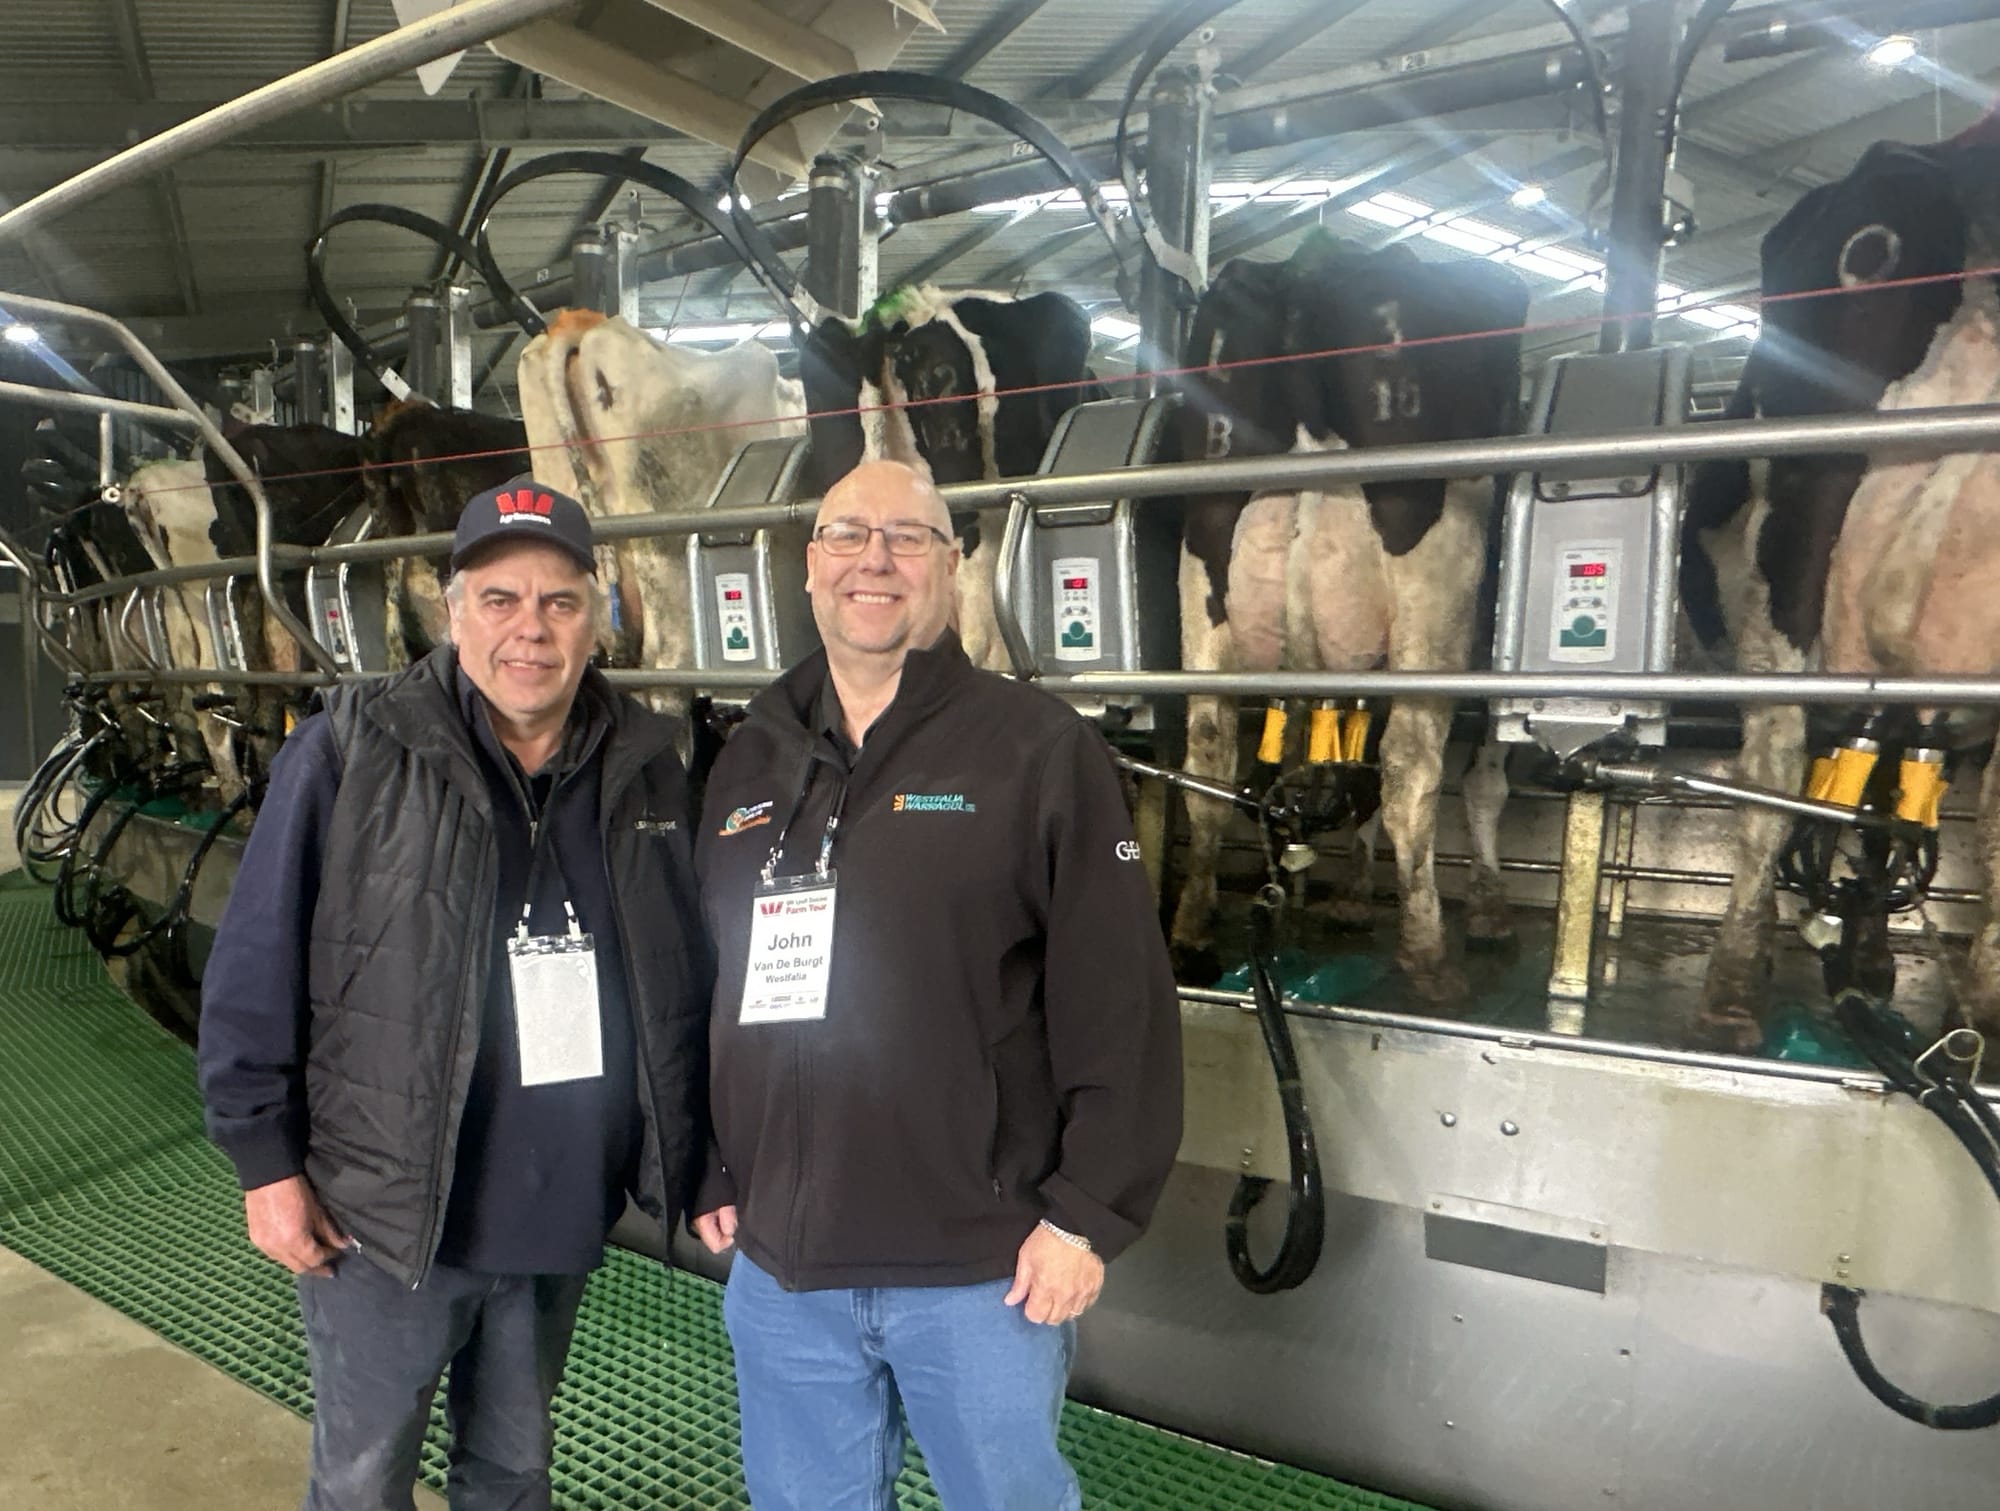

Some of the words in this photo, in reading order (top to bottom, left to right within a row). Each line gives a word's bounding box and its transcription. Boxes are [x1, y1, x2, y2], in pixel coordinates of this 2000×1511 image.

[905, 793, 964, 802] WESTFALIA
[904, 801, 965, 811] WARRAGUL
[786, 906, 807, 915] Farm
[809, 904, 827, 912] Tour
[768, 932, 812, 951] John
[754, 961, 773, 971] Van
[776, 959, 790, 969] De
[793, 956, 823, 968] Burgt
[765, 972, 807, 984] Westfalia
